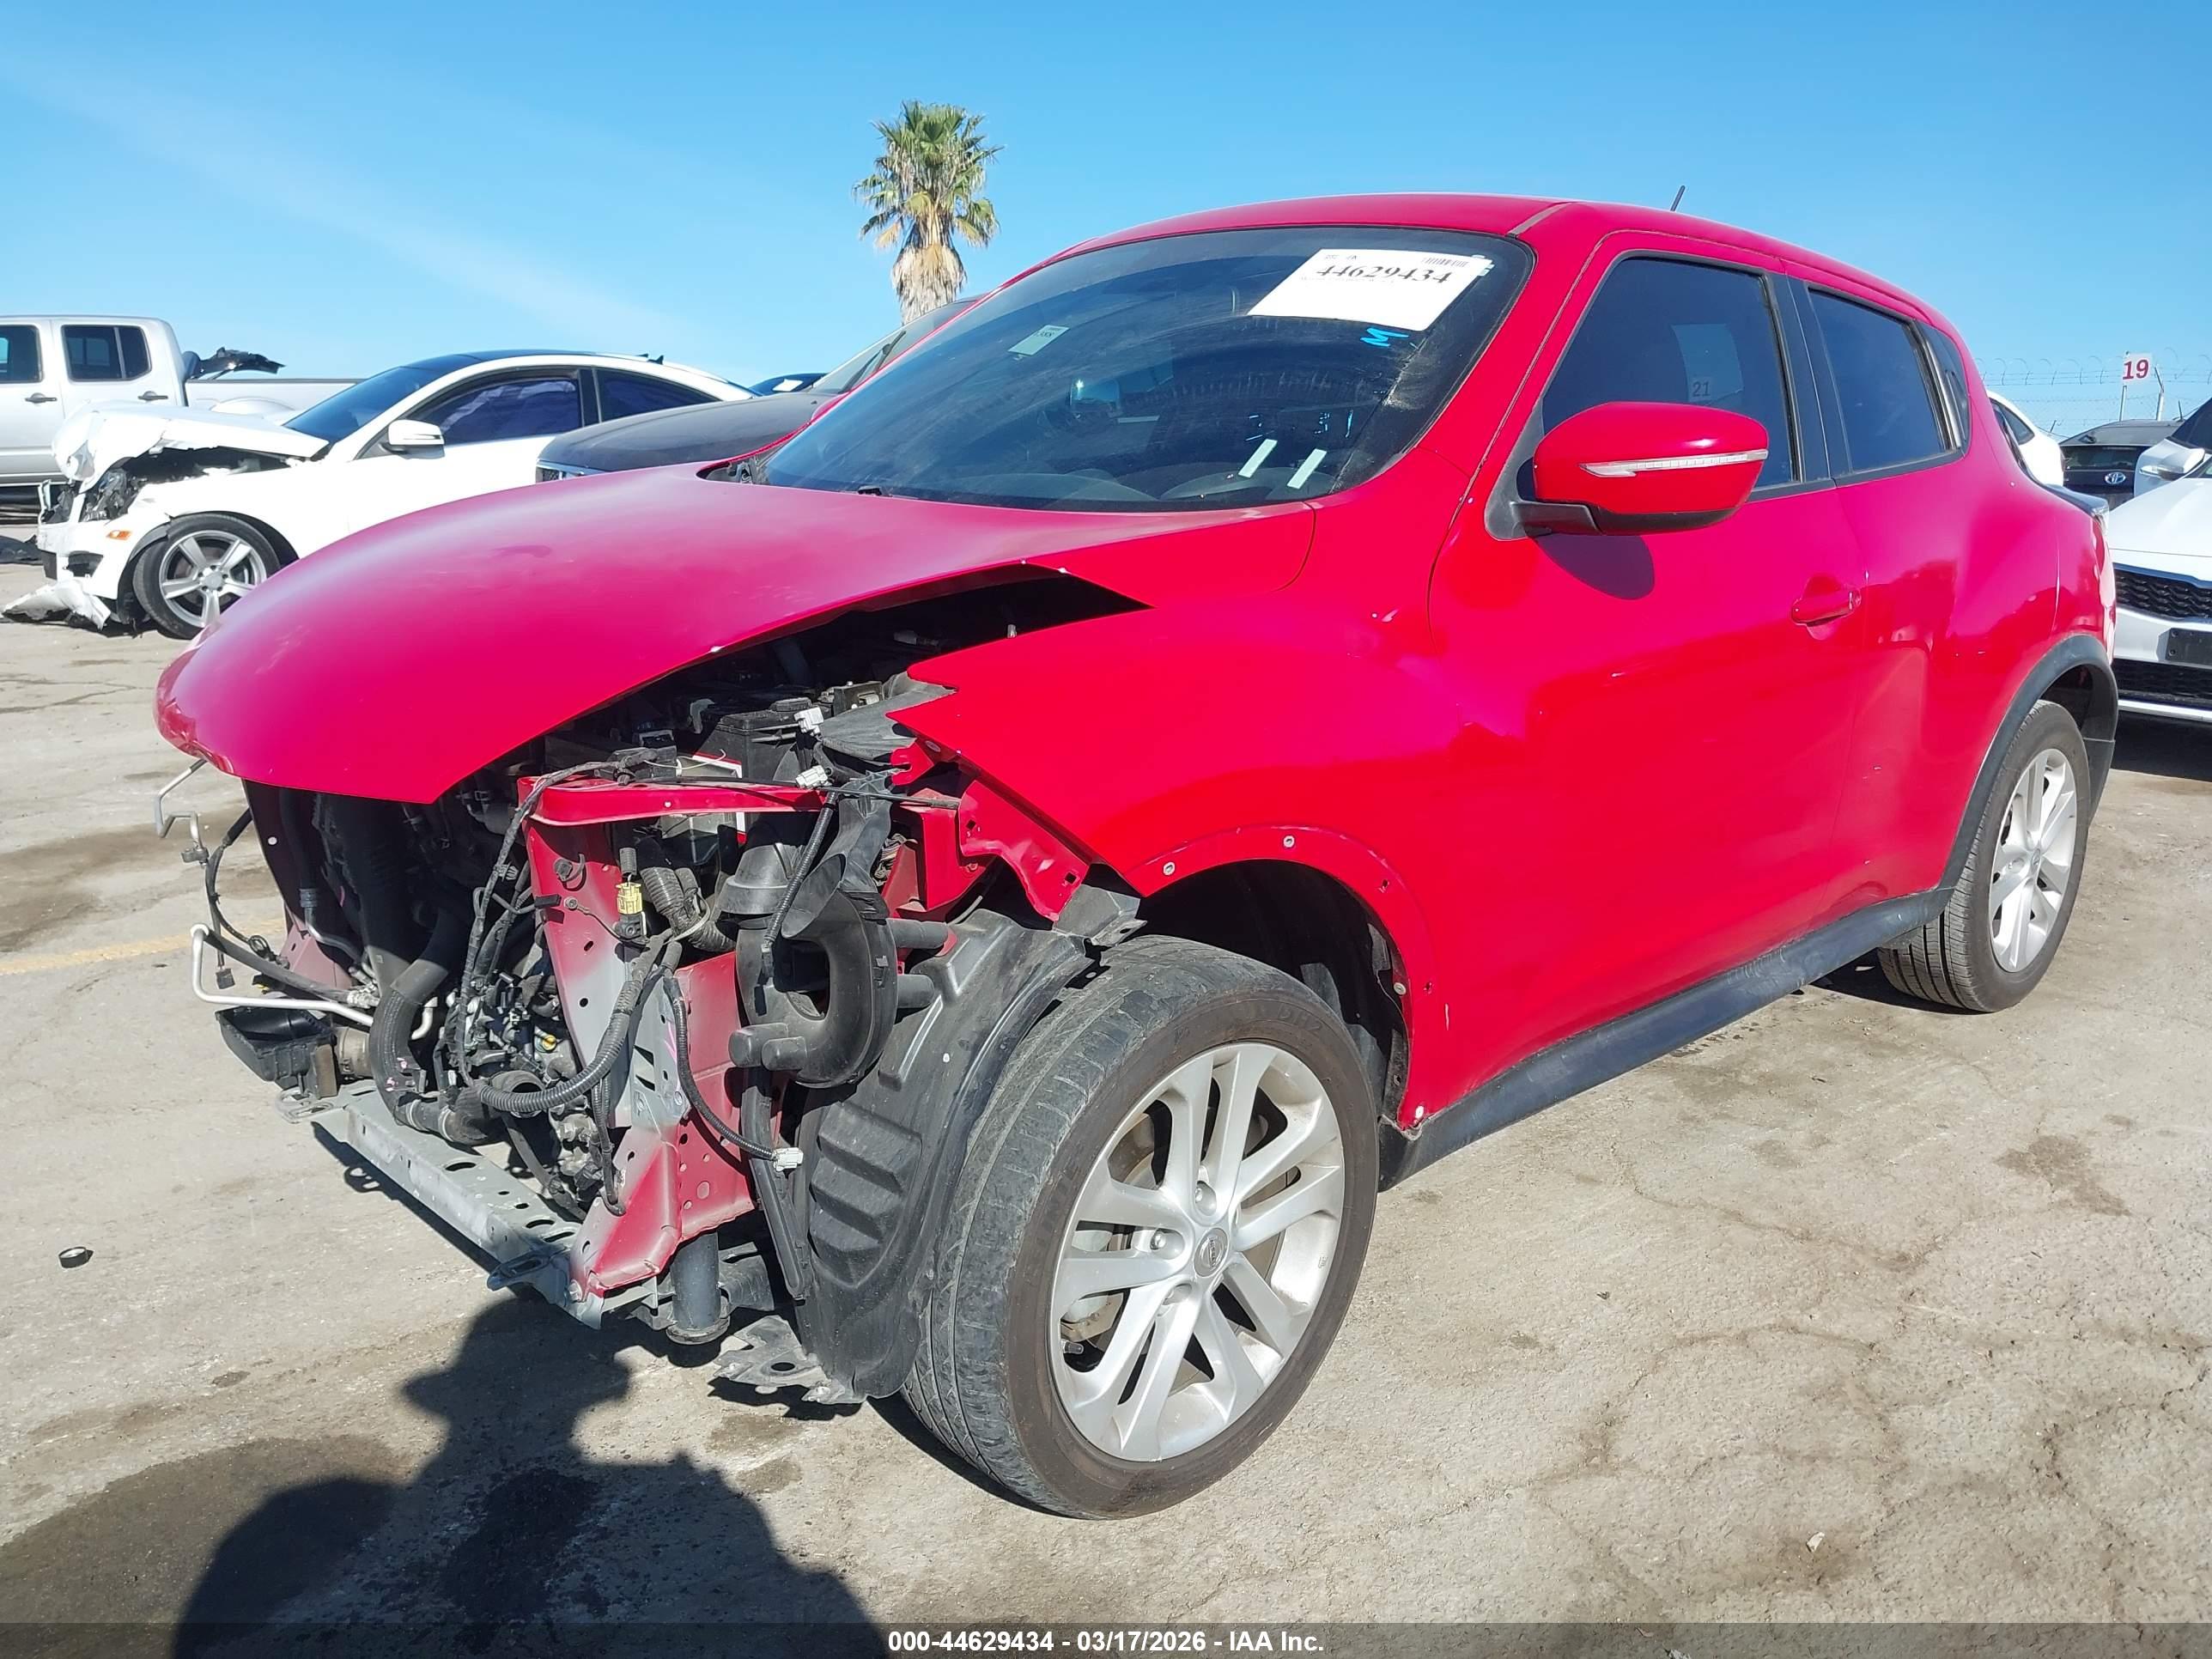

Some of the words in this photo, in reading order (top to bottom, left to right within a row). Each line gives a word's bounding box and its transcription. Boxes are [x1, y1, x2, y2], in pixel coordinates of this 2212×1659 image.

[1316, 264, 1452, 283] 44629434
[2122, 359, 2149, 380] 19
[1692, 381, 1711, 397] 21
